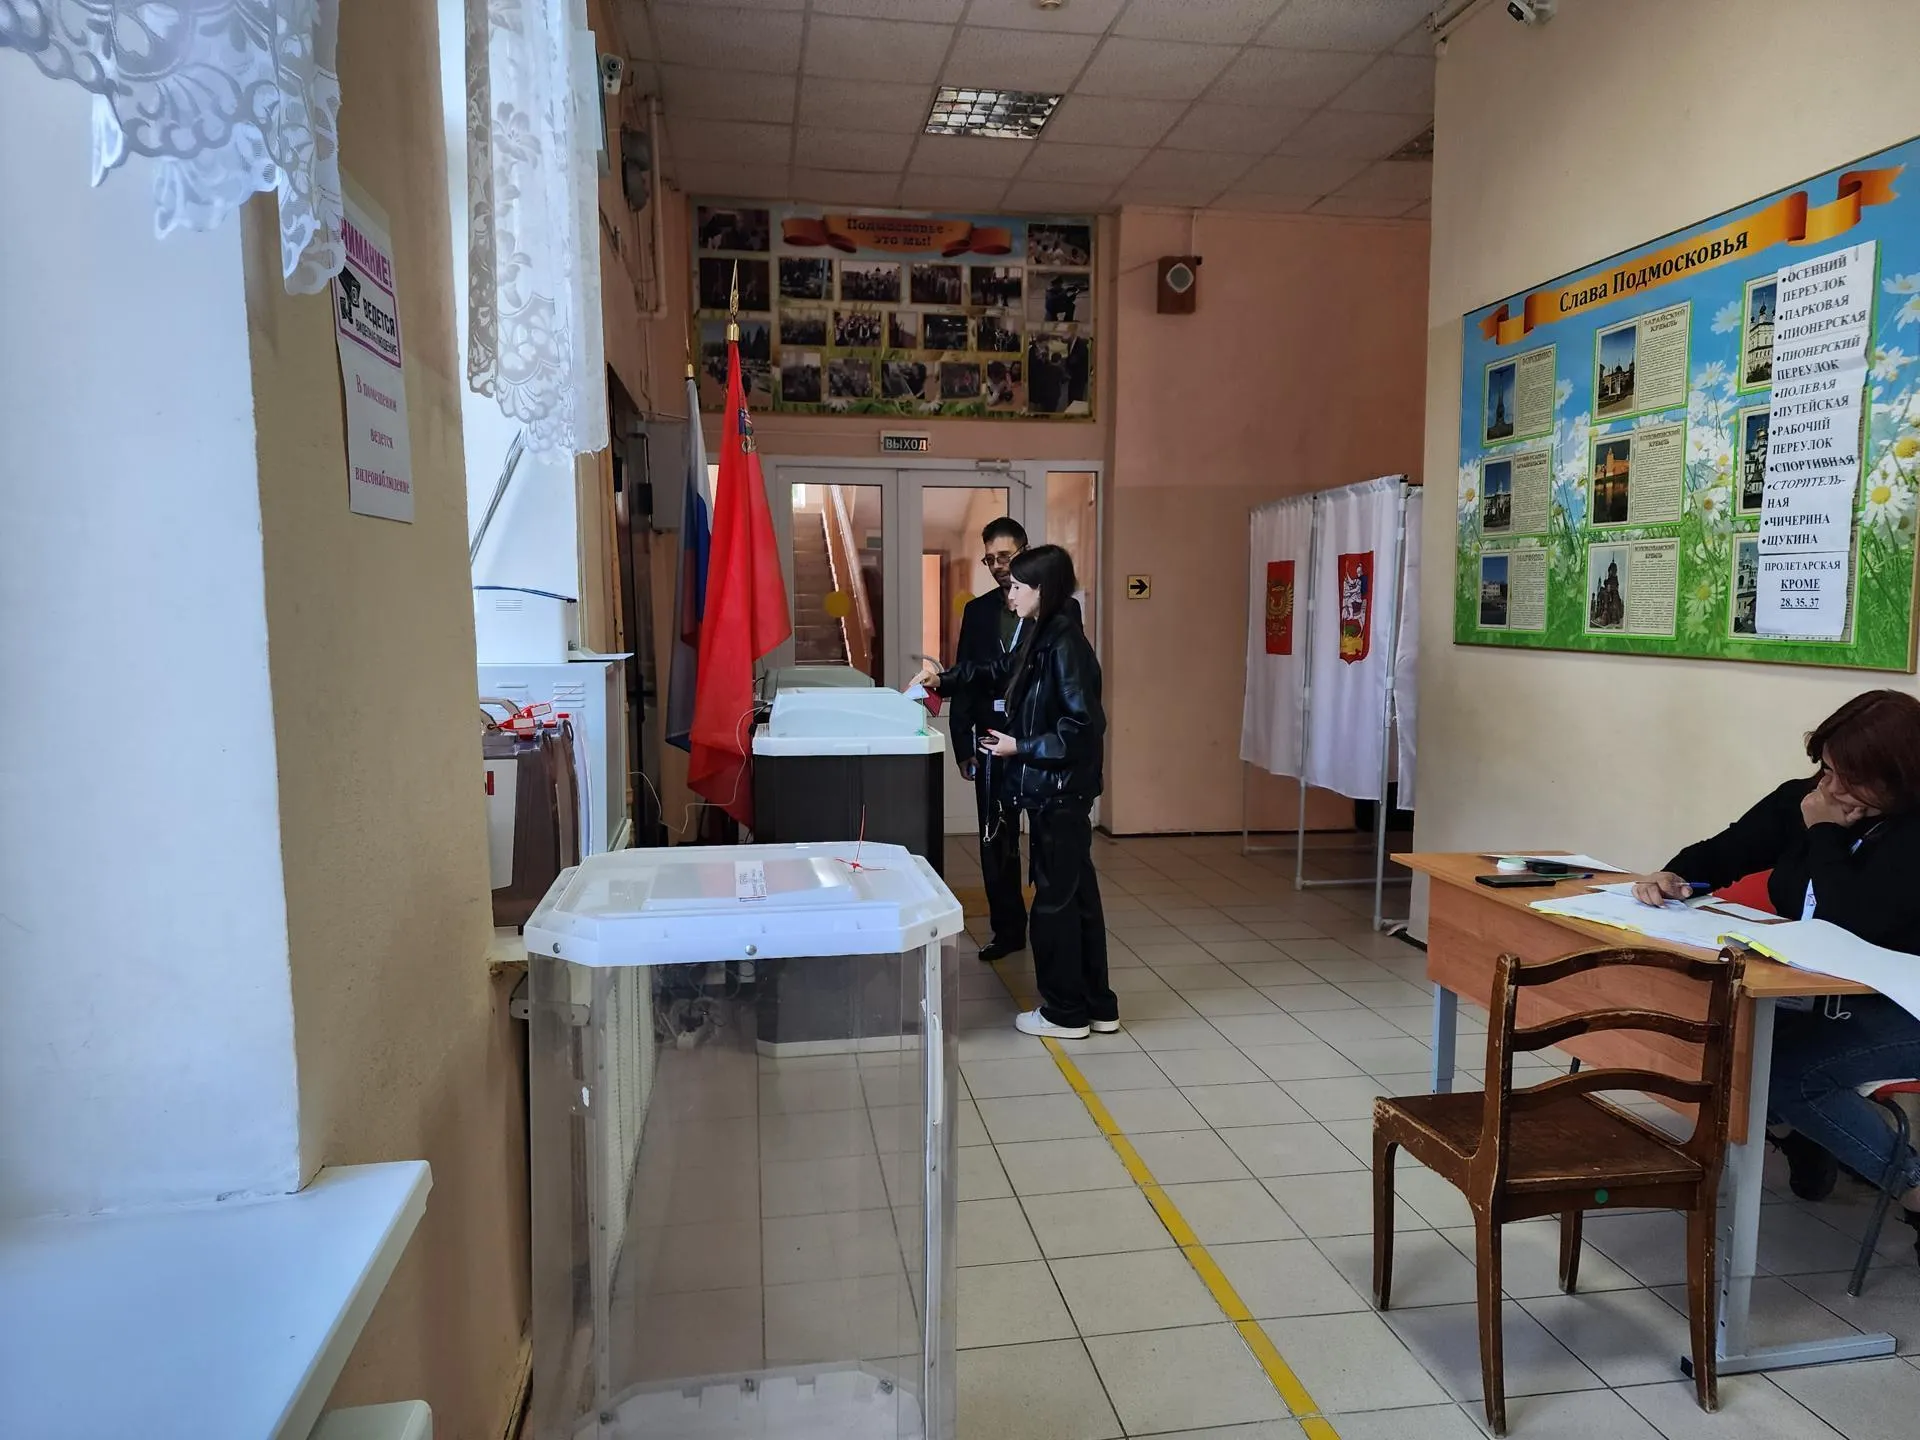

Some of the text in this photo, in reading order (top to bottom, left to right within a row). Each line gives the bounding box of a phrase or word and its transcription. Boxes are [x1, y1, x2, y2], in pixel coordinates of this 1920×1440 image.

[1559, 231, 1749, 312] Слава Подмосковья
[1782, 275, 1848, 303] ПЕРЕУЛОК
[362, 297, 396, 337] ВЕДЕТСЯ
[1777, 359, 1841, 381] ПЕРЕУЛОК
[886, 438, 926, 450] ВЫХОД
[1772, 437, 1834, 455] ПЕРЕУЛОК
[1767, 497, 1790, 509] НАЯ
[1764, 560, 1841, 572] ПРОЛЕТАРСКАЯ
[1780, 578, 1821, 590] КРОМЕ
[1780, 598, 1819, 608] 28, 35, 37
